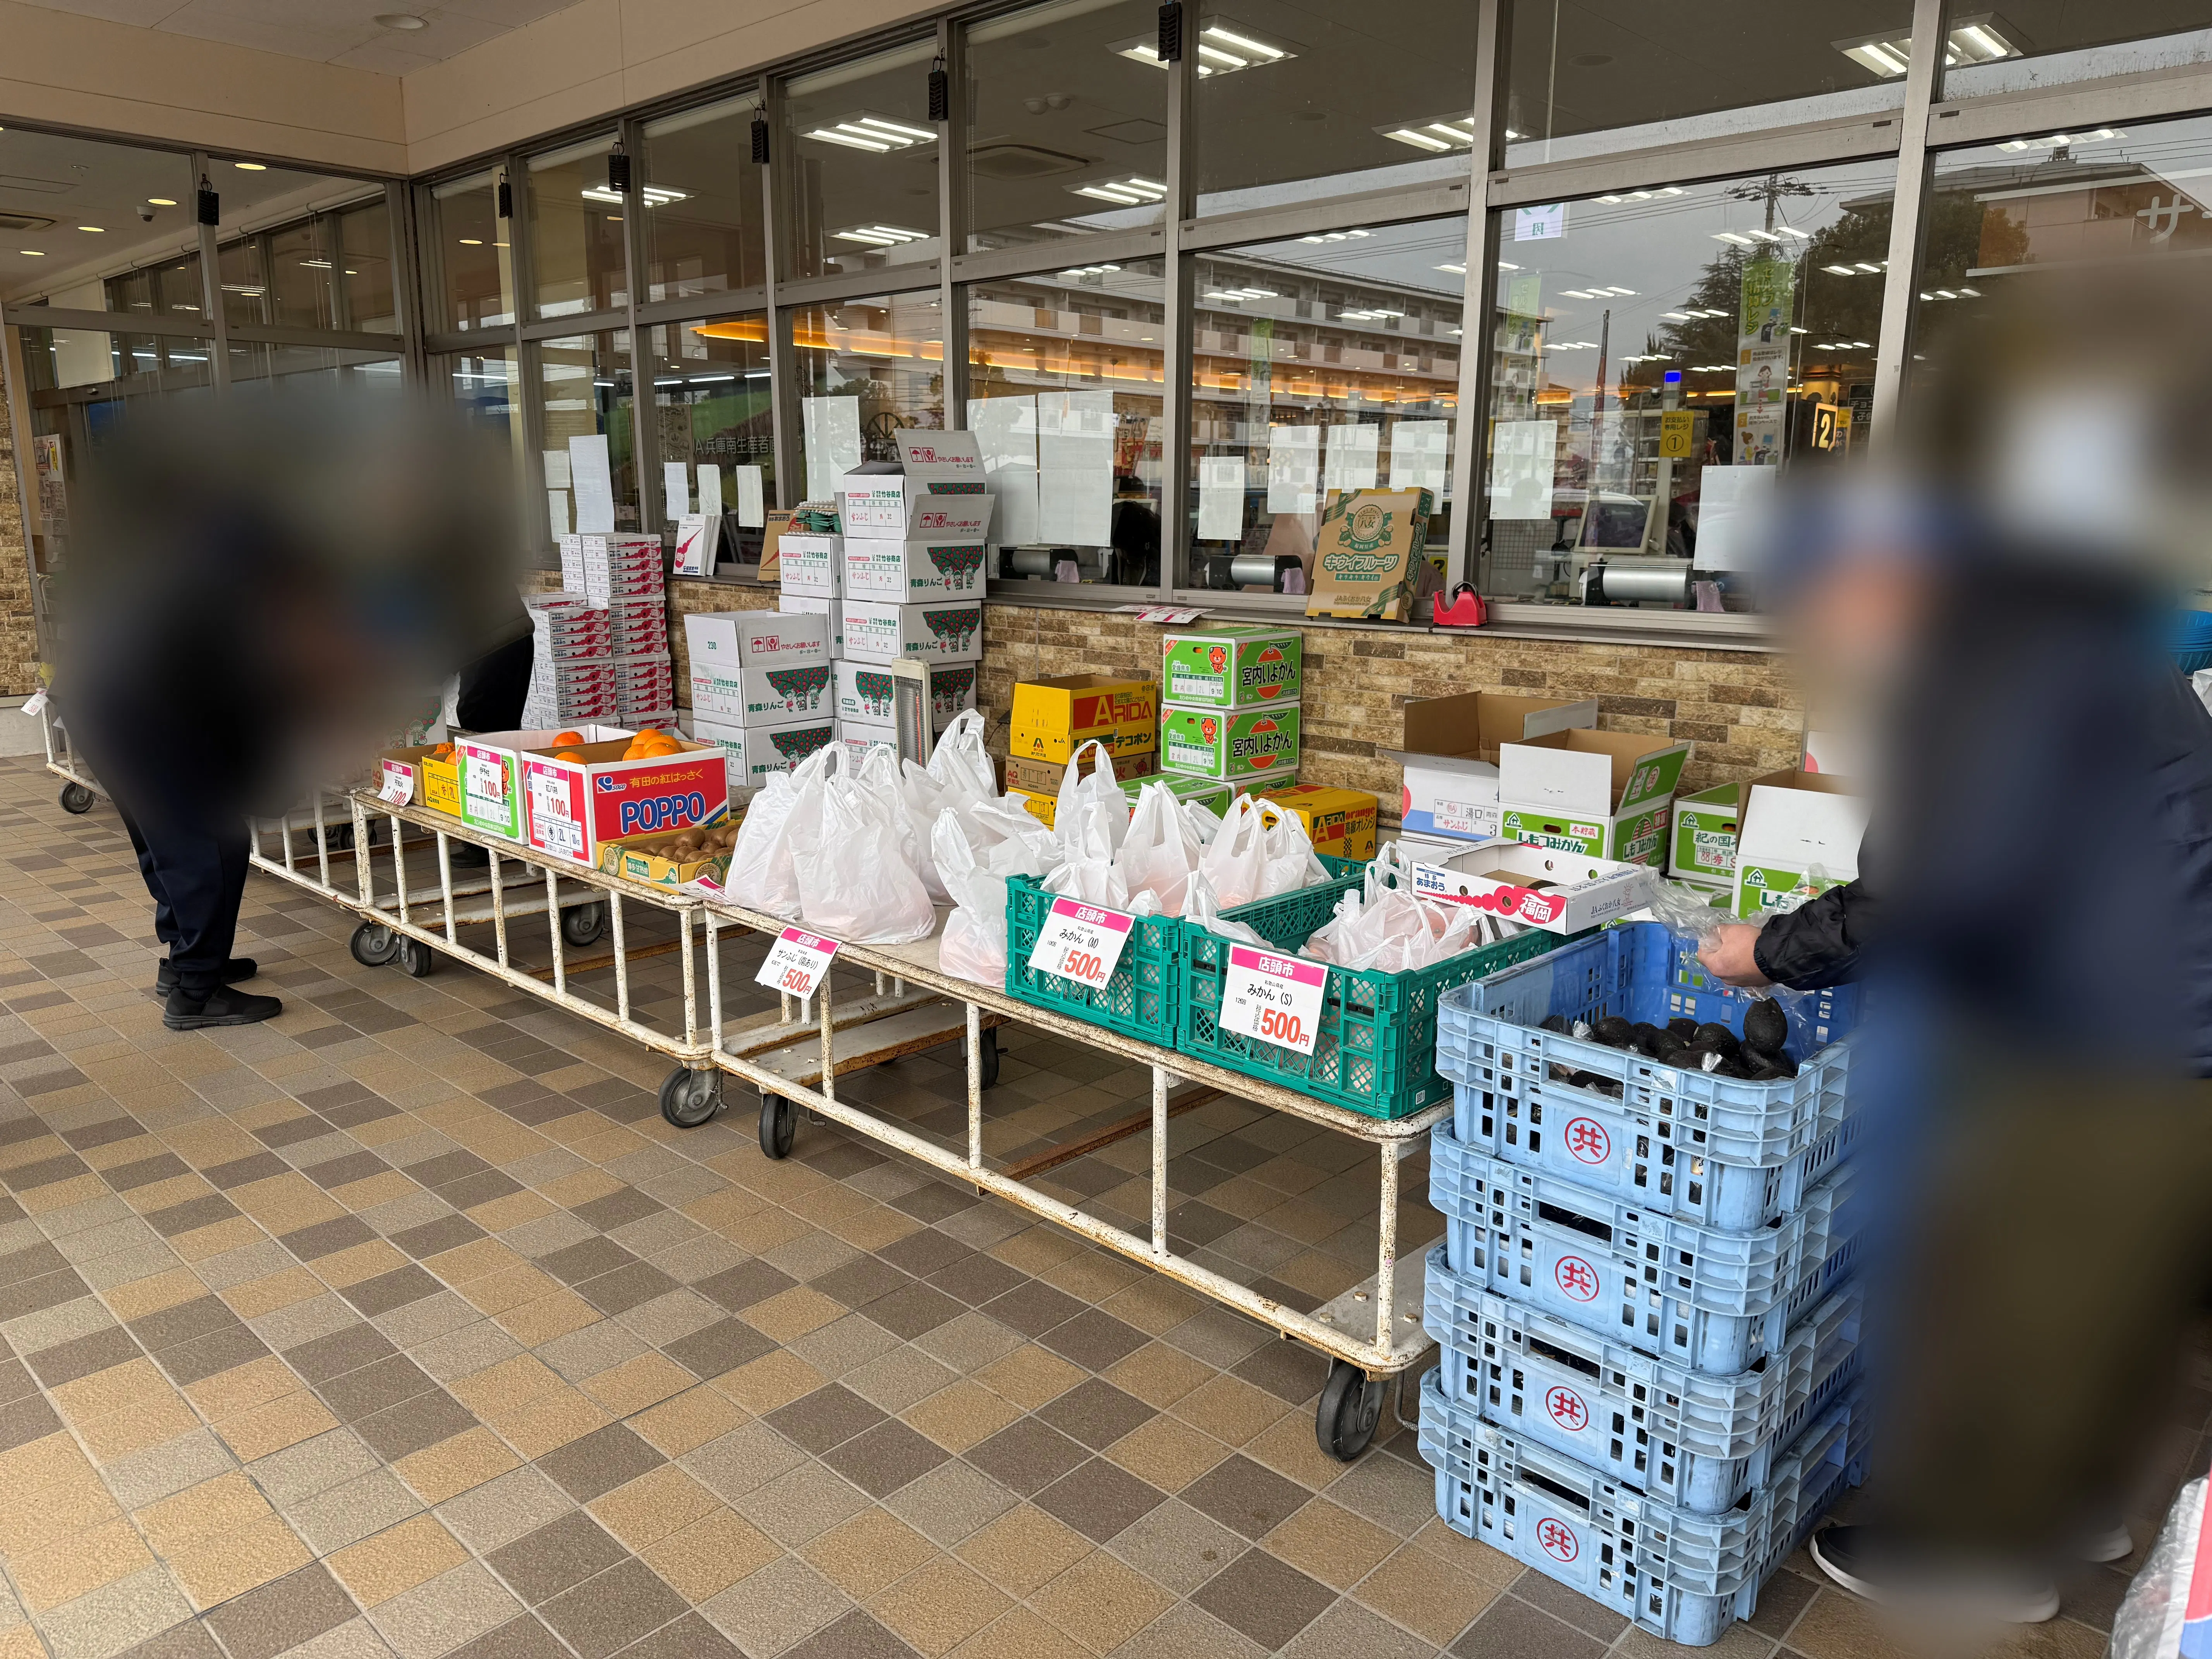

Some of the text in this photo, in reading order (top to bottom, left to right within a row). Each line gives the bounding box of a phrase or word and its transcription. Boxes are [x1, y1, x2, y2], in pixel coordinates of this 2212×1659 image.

[1819, 414, 1830, 448] 2
[852, 512, 868, 522] サンふじ
[1359, 520, 1376, 529] 八女
[1407, 522, 1422, 581] キウイフルーツ
[1324, 555, 1398, 571] キウイフルーツ
[785, 573, 800, 581] サンふじ
[852, 572, 869, 581] サンふじ
[910, 577, 942, 587] 青森りんご
[878, 618, 896, 627] 竹谷商店
[708, 641, 716, 650] 230
[781, 641, 820, 650] やさしくお願いします
[849, 637, 866, 646] サンふじ
[905, 641, 938, 651] 青森りんご
[1242, 660, 1296, 687] 宮内いよかん
[696, 693, 711, 702] サンふじ
[747, 701, 783, 713] 青森りんご
[1093, 696, 1153, 726] ARIDA
[725, 741, 742, 750] 竹谷商店
[1116, 733, 1152, 748] デコポン
[1233, 730, 1293, 758] 宮内いよかん
[477, 750, 490, 761] 店頭市
[543, 766, 557, 778] 店頭市
[752, 761, 787, 773] 青森りんご
[1008, 770, 1018, 779] AQ
[630, 769, 704, 788] 有田の紅はっさく
[484, 780, 501, 799] 100円
[551, 797, 569, 818] 100円
[621, 792, 705, 834] POPPO
[1466, 807, 1482, 819] 湯口
[505, 815, 510, 823] 10
[1313, 806, 1375, 843] ARIDA orange
[1345, 816, 1375, 835] 高級オレンジ
[1443, 819, 1468, 831] サンふじ
[559, 828, 566, 842] 2L
[1518, 832, 1585, 854] しもつみかん
[1624, 835, 1658, 859] しもつみかん
[1701, 851, 1710, 862] 88
[1713, 854, 1723, 865] 秀
[1416, 877, 1445, 892] あまおう
[1519, 893, 1553, 922] 福岡
[1591, 897, 1621, 915] JAふくおか八女
[1075, 907, 1108, 925] 店頭市
[796, 933, 821, 948] 店頭市
[1059, 928, 1084, 944] みかん
[776, 949, 797, 962] サンふじ
[1064, 949, 1106, 983] 500円
[1257, 956, 1295, 978] 店頭市
[782, 968, 812, 994] 500円
[1247, 983, 1275, 1001] みかん
[1252, 1003, 1262, 1032] 税込価格
[1261, 1008, 1310, 1047] 500円
[1572, 1124, 1602, 1158] 共
[1563, 1262, 1591, 1297] 共
[1553, 1392, 1581, 1426] 共
[1544, 1523, 1571, 1558] 共
